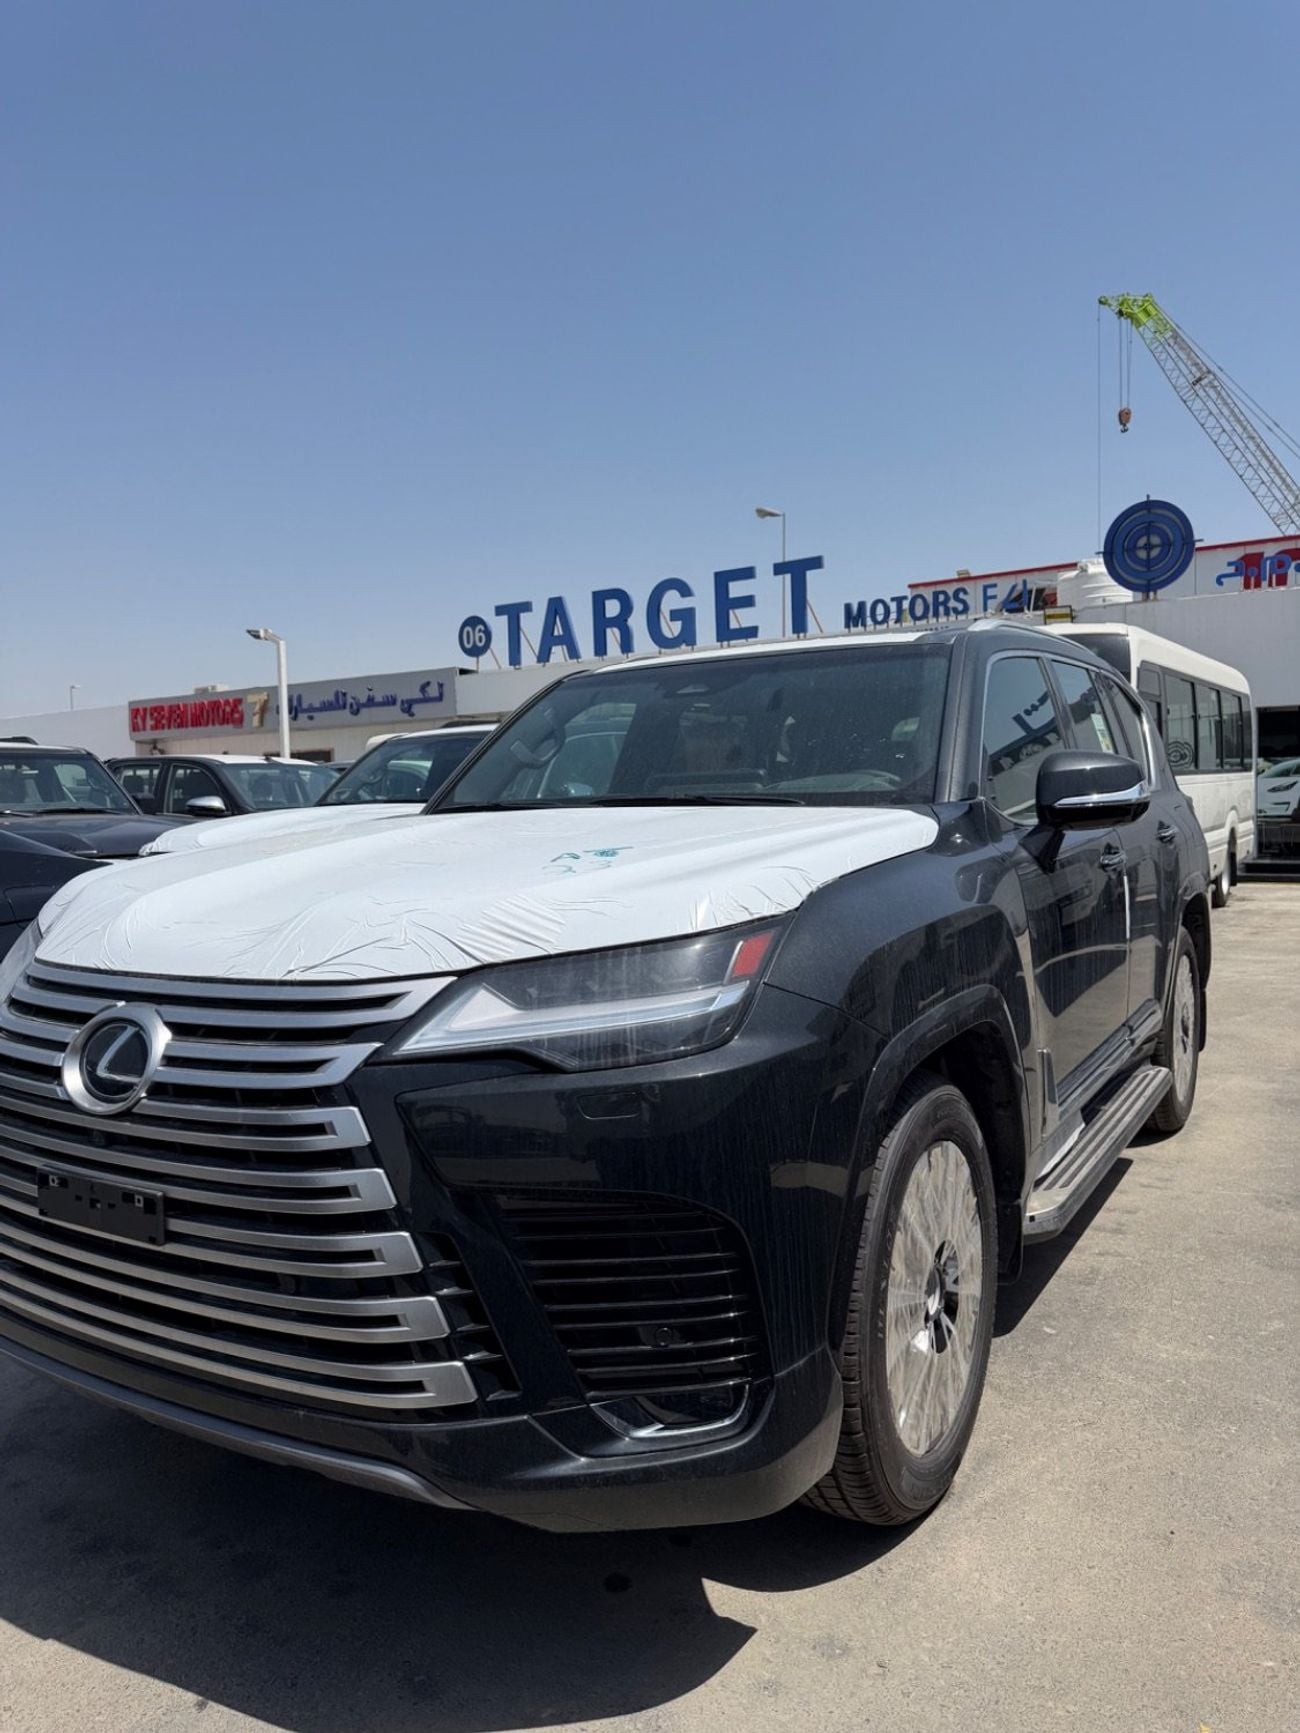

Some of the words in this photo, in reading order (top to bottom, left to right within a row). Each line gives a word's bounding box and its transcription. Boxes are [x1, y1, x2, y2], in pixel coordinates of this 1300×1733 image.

[494, 555, 824, 667] TARGET
[843, 587, 970, 630] MOTORS
[463, 624, 487, 649] 06
[149, 703, 189, 731] SEVEN
[190, 698, 244, 729] MOTORS
[246, 691, 269, 728] 7
[275, 689, 348, 721] للسيارا
